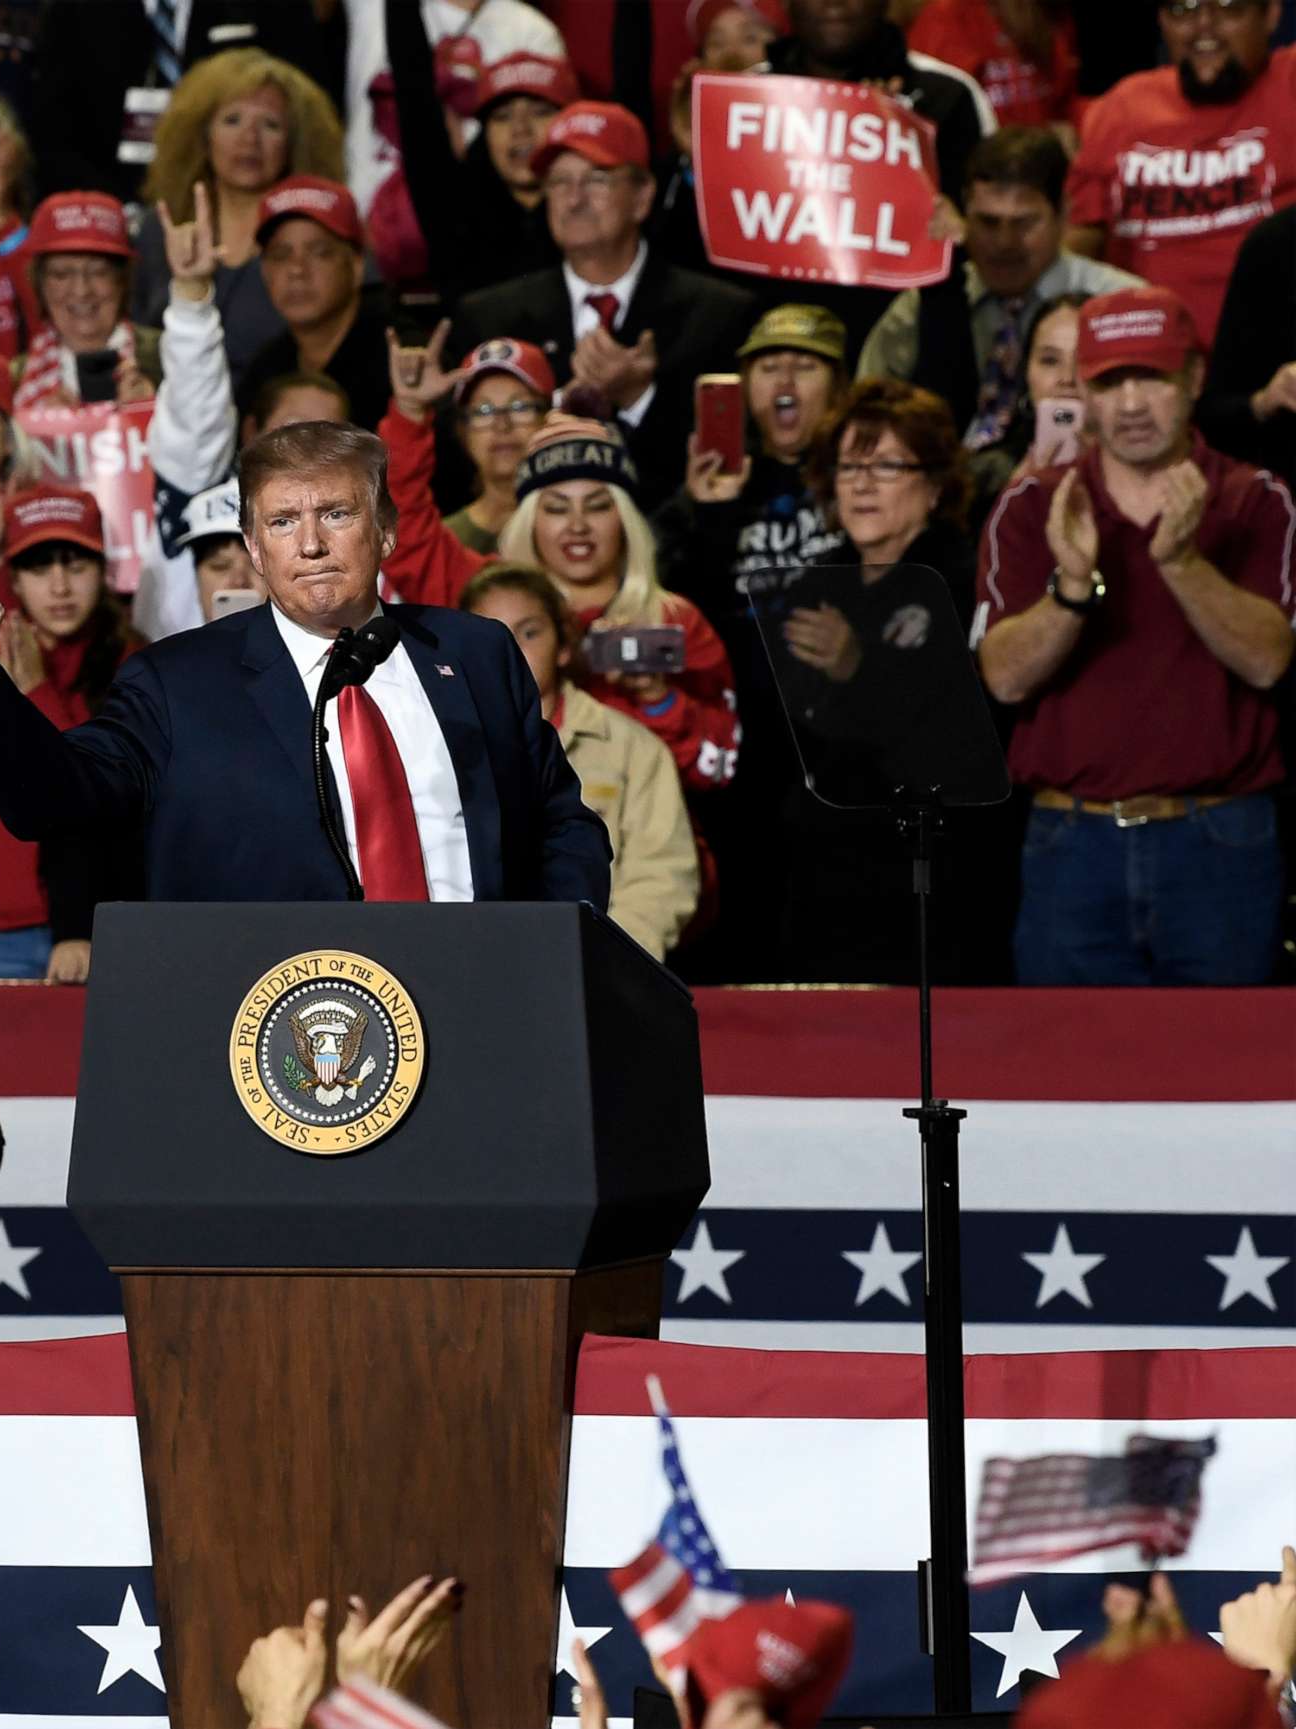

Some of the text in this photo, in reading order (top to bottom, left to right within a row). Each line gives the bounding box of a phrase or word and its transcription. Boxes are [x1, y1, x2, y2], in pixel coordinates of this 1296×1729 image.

[726, 102, 923, 170] FINISH
[1125, 140, 1265, 187] TRUMP
[785, 159, 853, 193] THE
[731, 188, 911, 256] WALL
[238, 958, 418, 1144] SEAL OF THE PRESIDENT OF THE UNITED STATES
